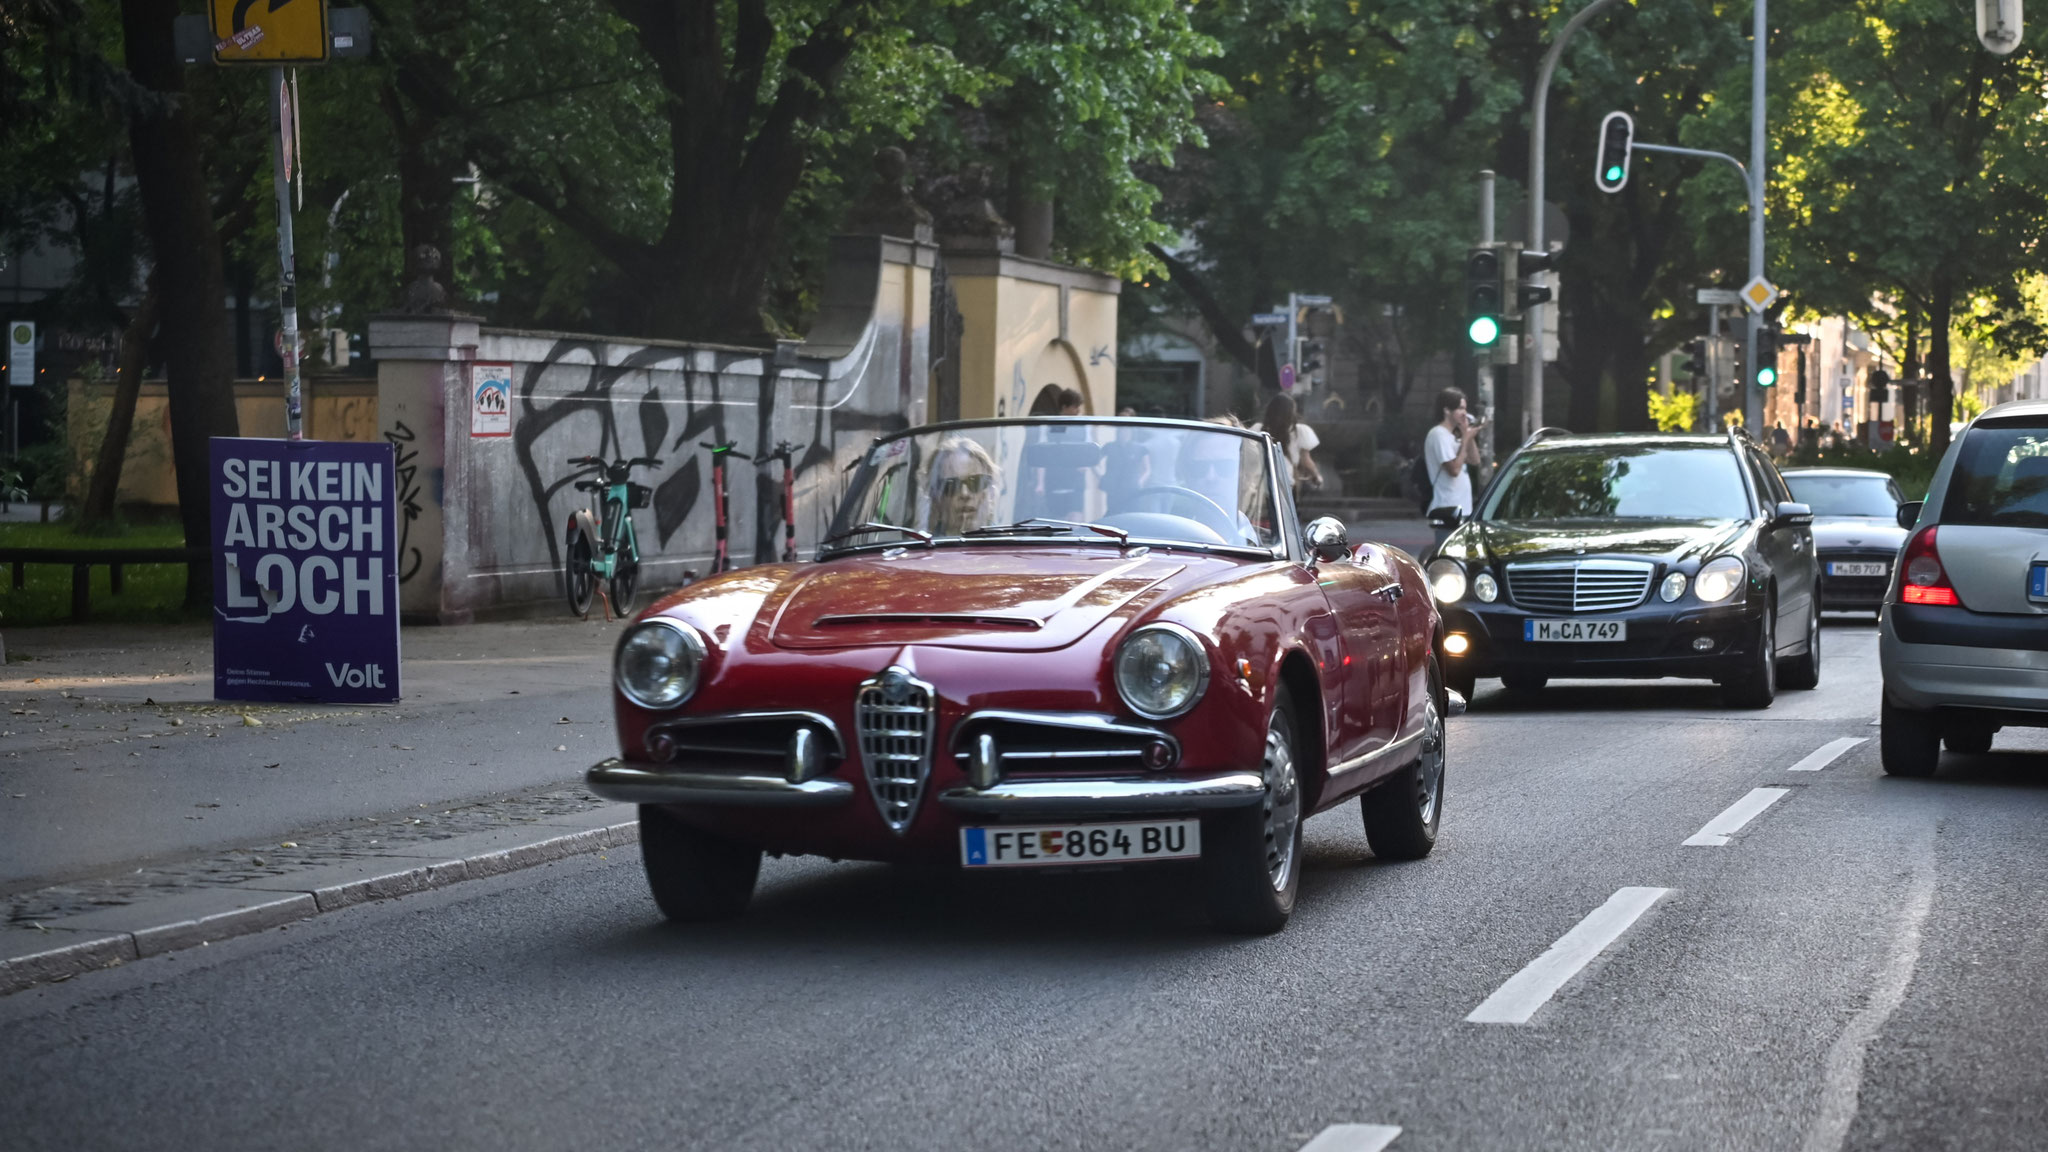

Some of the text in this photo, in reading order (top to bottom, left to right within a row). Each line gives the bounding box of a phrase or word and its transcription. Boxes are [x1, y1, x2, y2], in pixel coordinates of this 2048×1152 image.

[222, 458, 383, 501] SEI KEIN
[224, 502, 383, 551] ARSCH
[1863, 565, 1881, 574] 707
[224, 552, 384, 615] LOCH
[1539, 622, 1619, 639] M CA 749
[226, 667, 270, 677] Deine Stimme
[226, 678, 246, 686] gegen
[325, 662, 386, 688] Volt
[994, 825, 1185, 860] FE 864 BU
